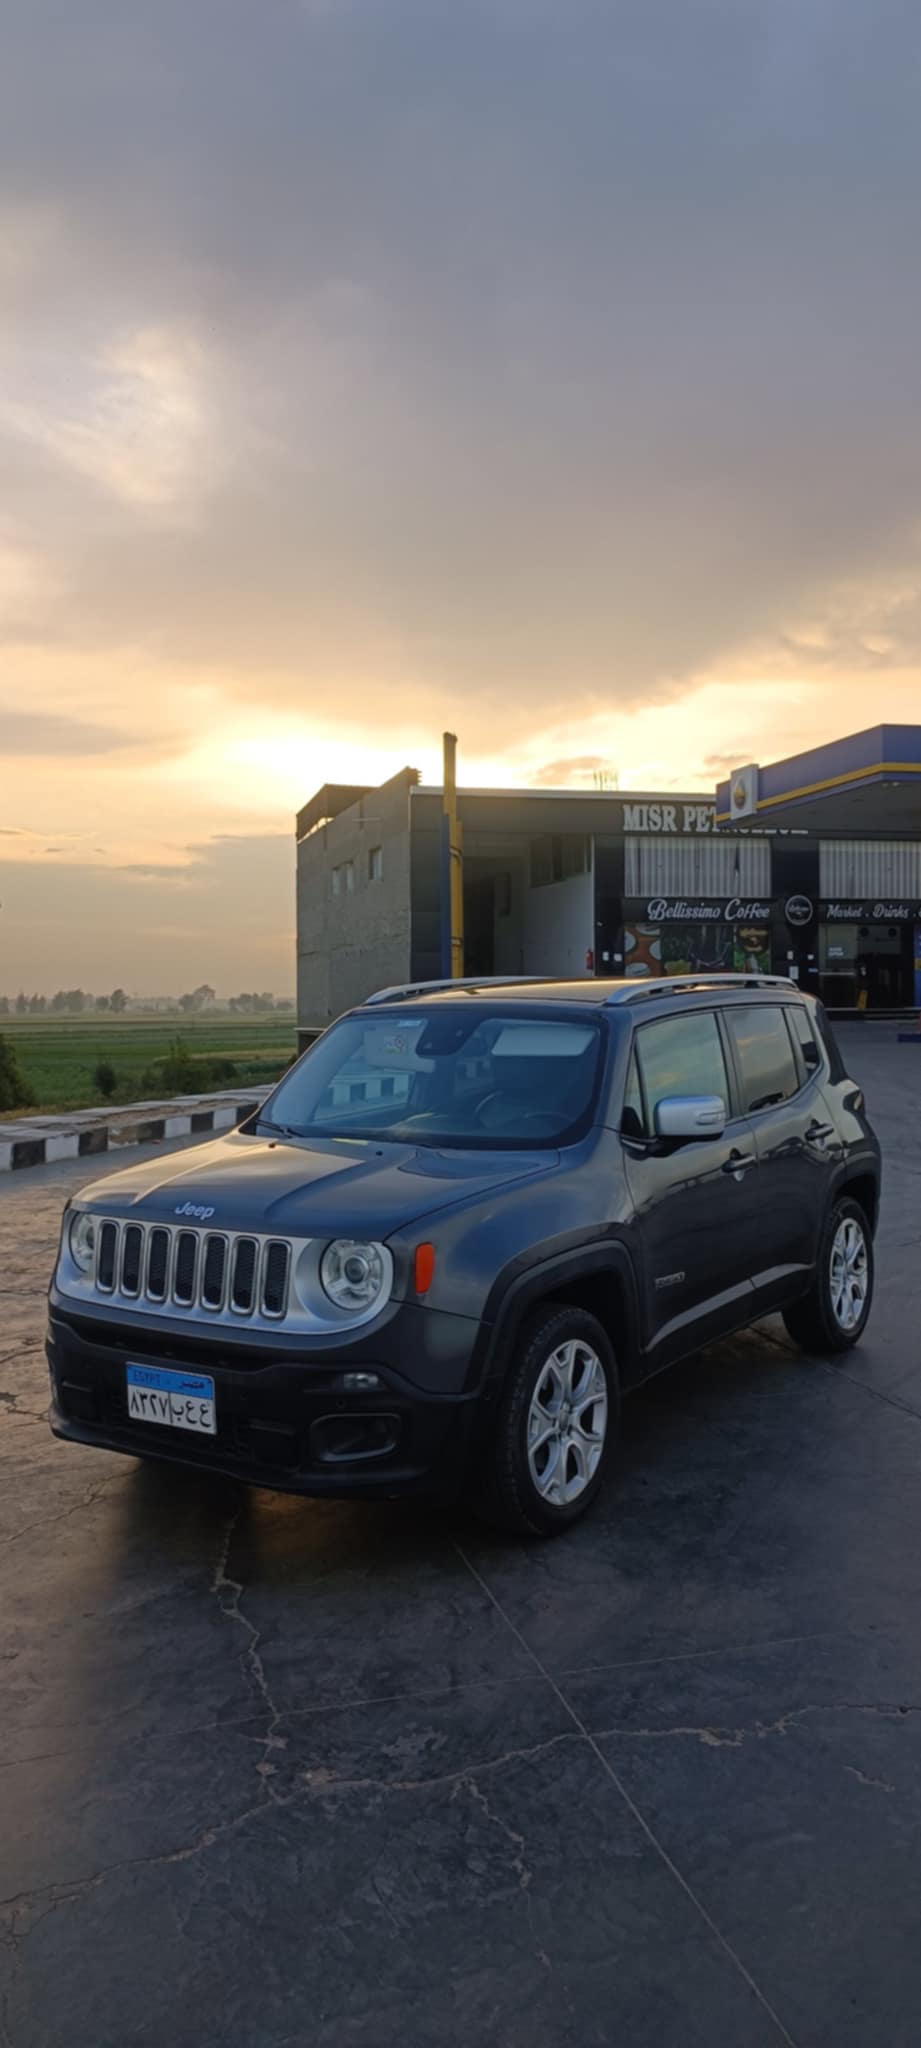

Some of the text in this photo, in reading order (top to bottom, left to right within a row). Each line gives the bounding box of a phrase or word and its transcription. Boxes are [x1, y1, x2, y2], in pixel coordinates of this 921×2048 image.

[622, 804, 678, 832] MISR
[647, 898, 721, 921] Bellissimo
[724, 898, 770, 921] Coffee
[826, 903, 864, 919] Market
[872, 903, 910, 919] Drinks
[174, 1200, 215, 1221] Jeep
